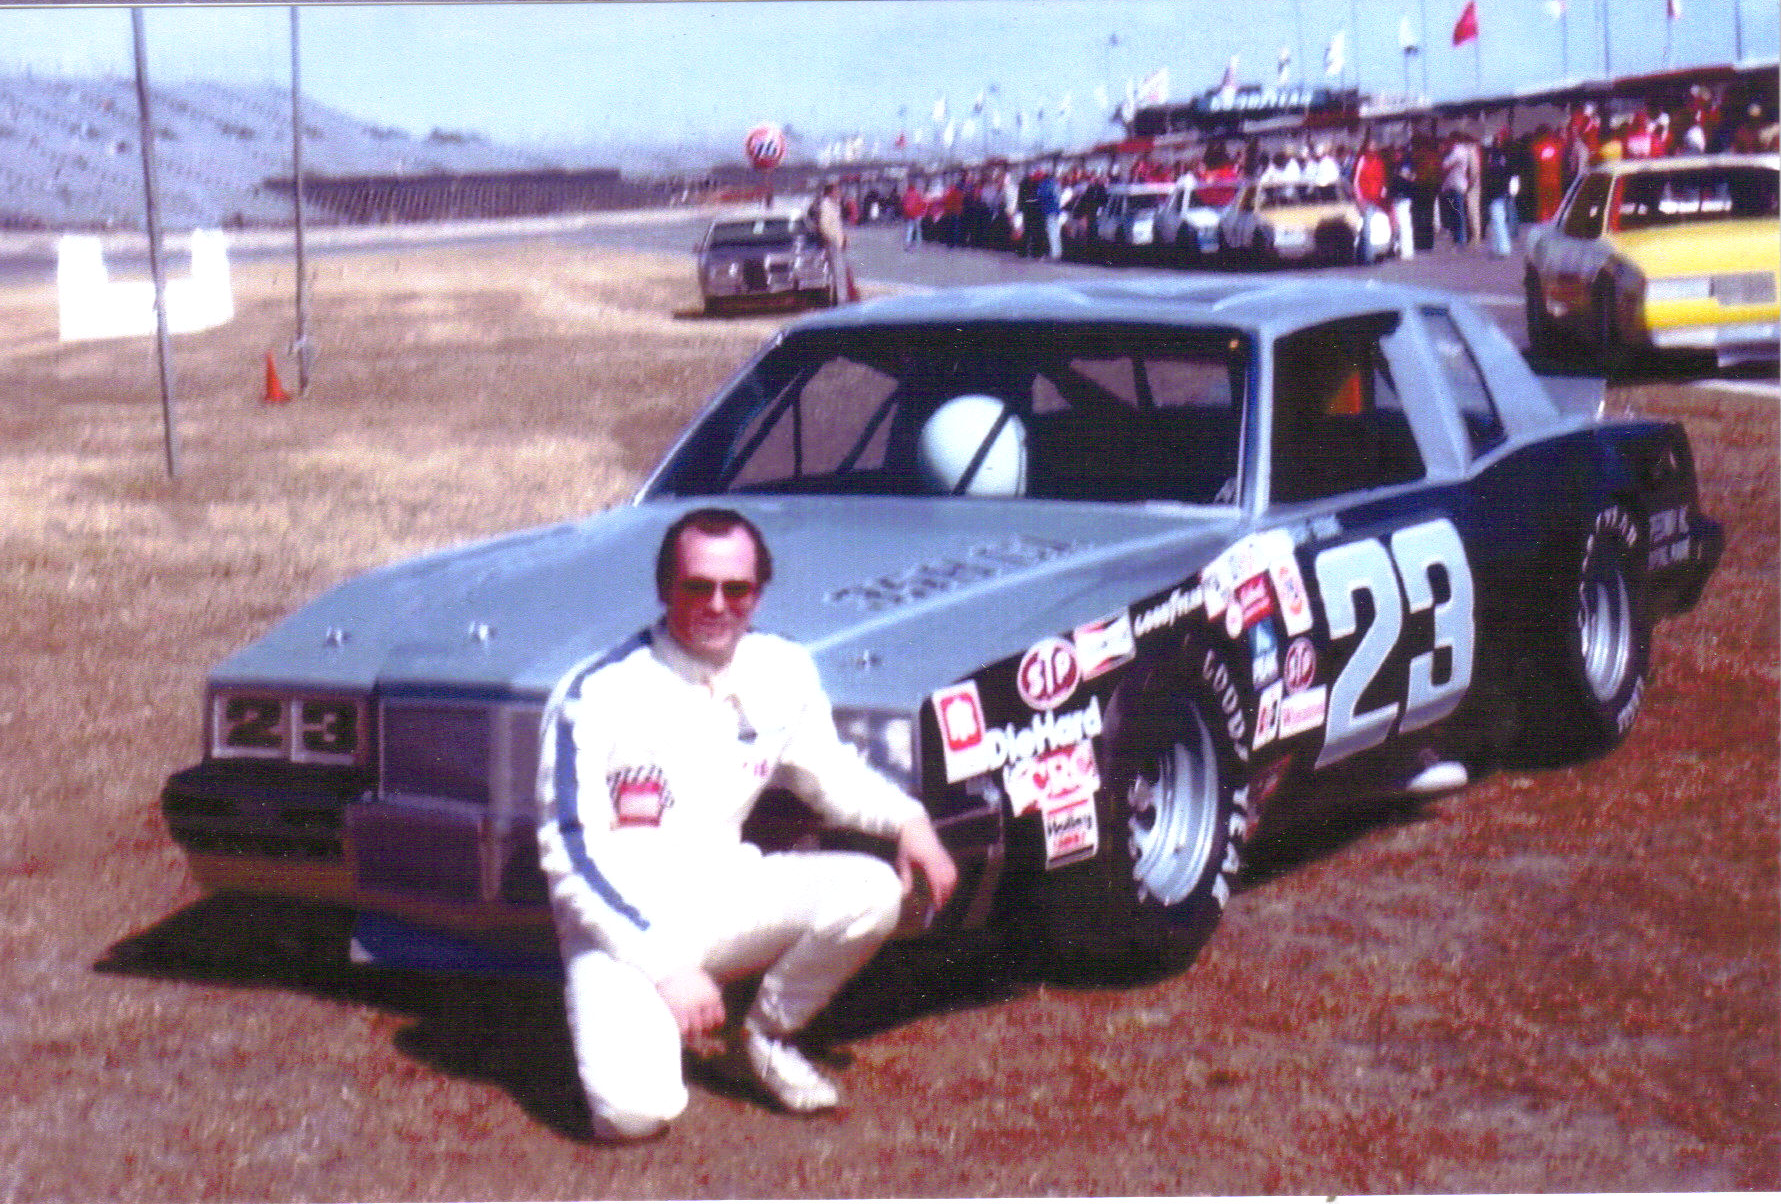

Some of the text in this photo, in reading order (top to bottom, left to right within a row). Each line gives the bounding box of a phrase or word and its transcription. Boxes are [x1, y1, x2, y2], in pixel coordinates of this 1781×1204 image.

[1022, 643, 1079, 703] STP
[1315, 517, 1475, 771] 23
[987, 694, 1102, 772] DieHard
